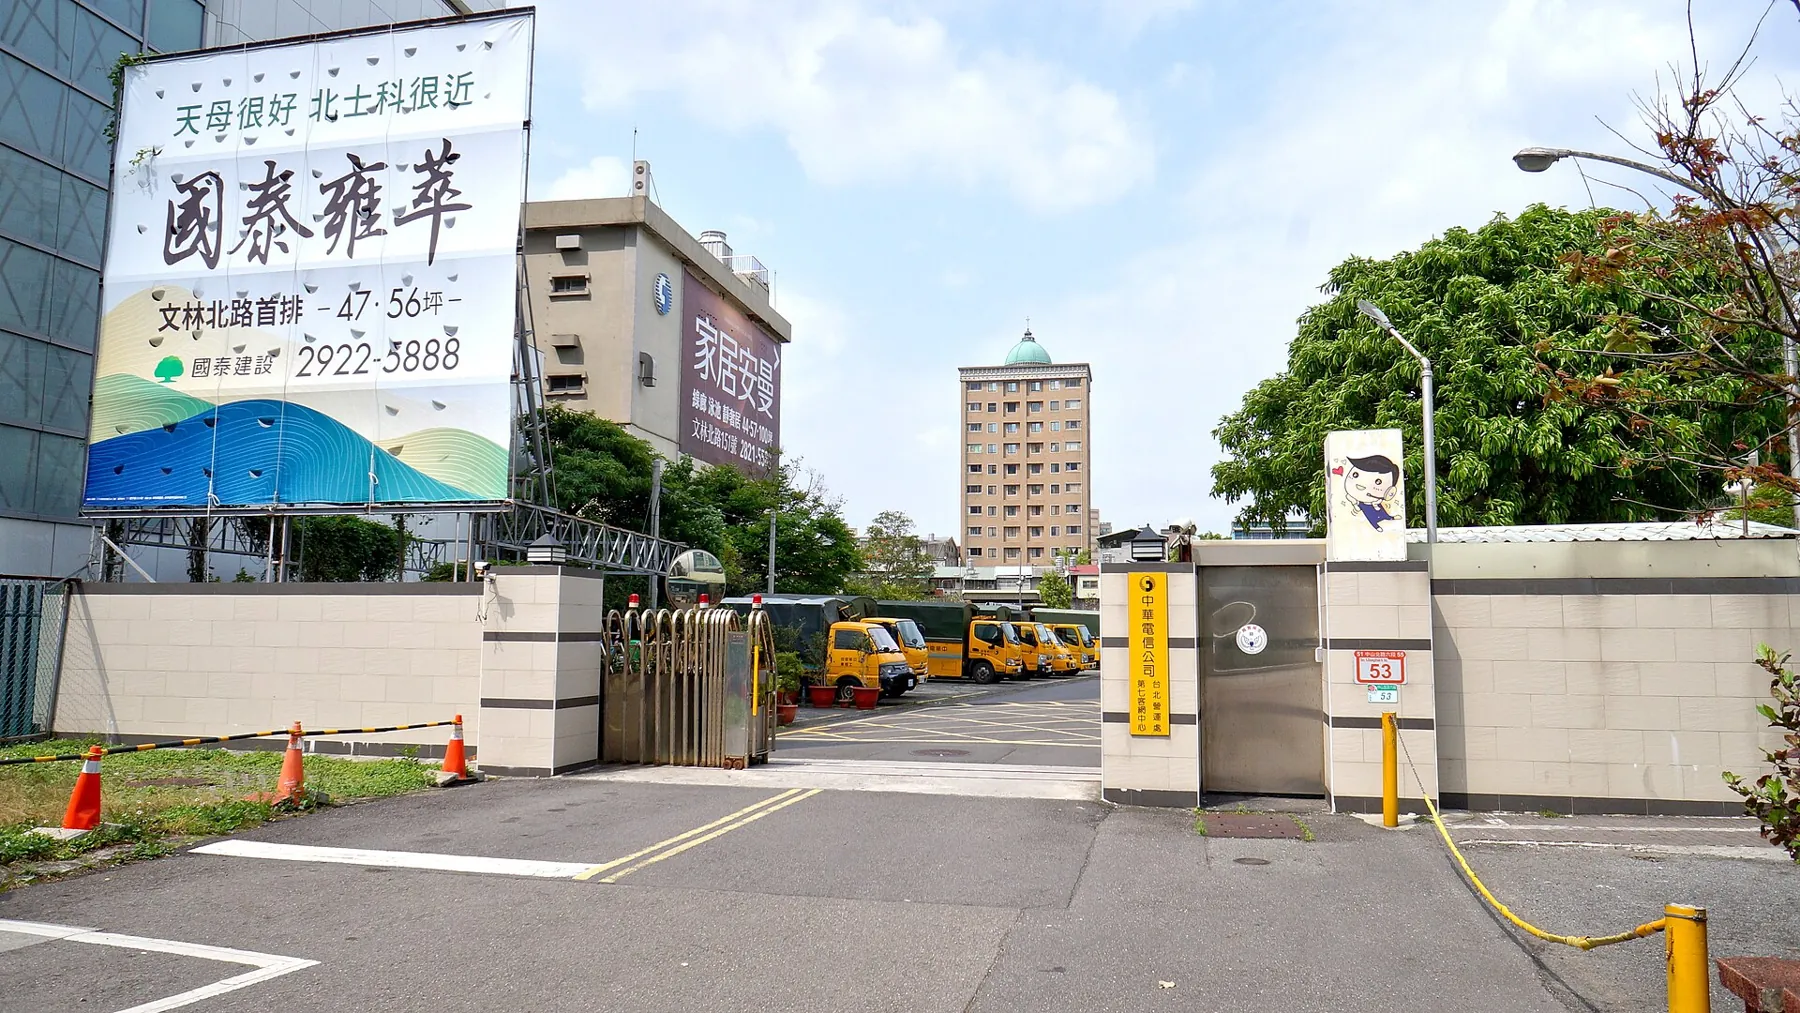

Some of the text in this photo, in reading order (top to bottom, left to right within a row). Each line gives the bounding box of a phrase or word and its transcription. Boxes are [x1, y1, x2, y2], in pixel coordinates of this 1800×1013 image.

[173, 71, 475, 137] 天母很好 北士科很近
[158, 295, 304, 332] 文林北路首排
[191, 354, 275, 379] 國泰建設
[295, 337, 461, 378] 2922-5888
[694, 316, 774, 420] 家居安曼
[1141, 595, 1155, 678] 中華電信公司
[1370, 663, 1392, 679] 53
[1380, 692, 1392, 701] 53
